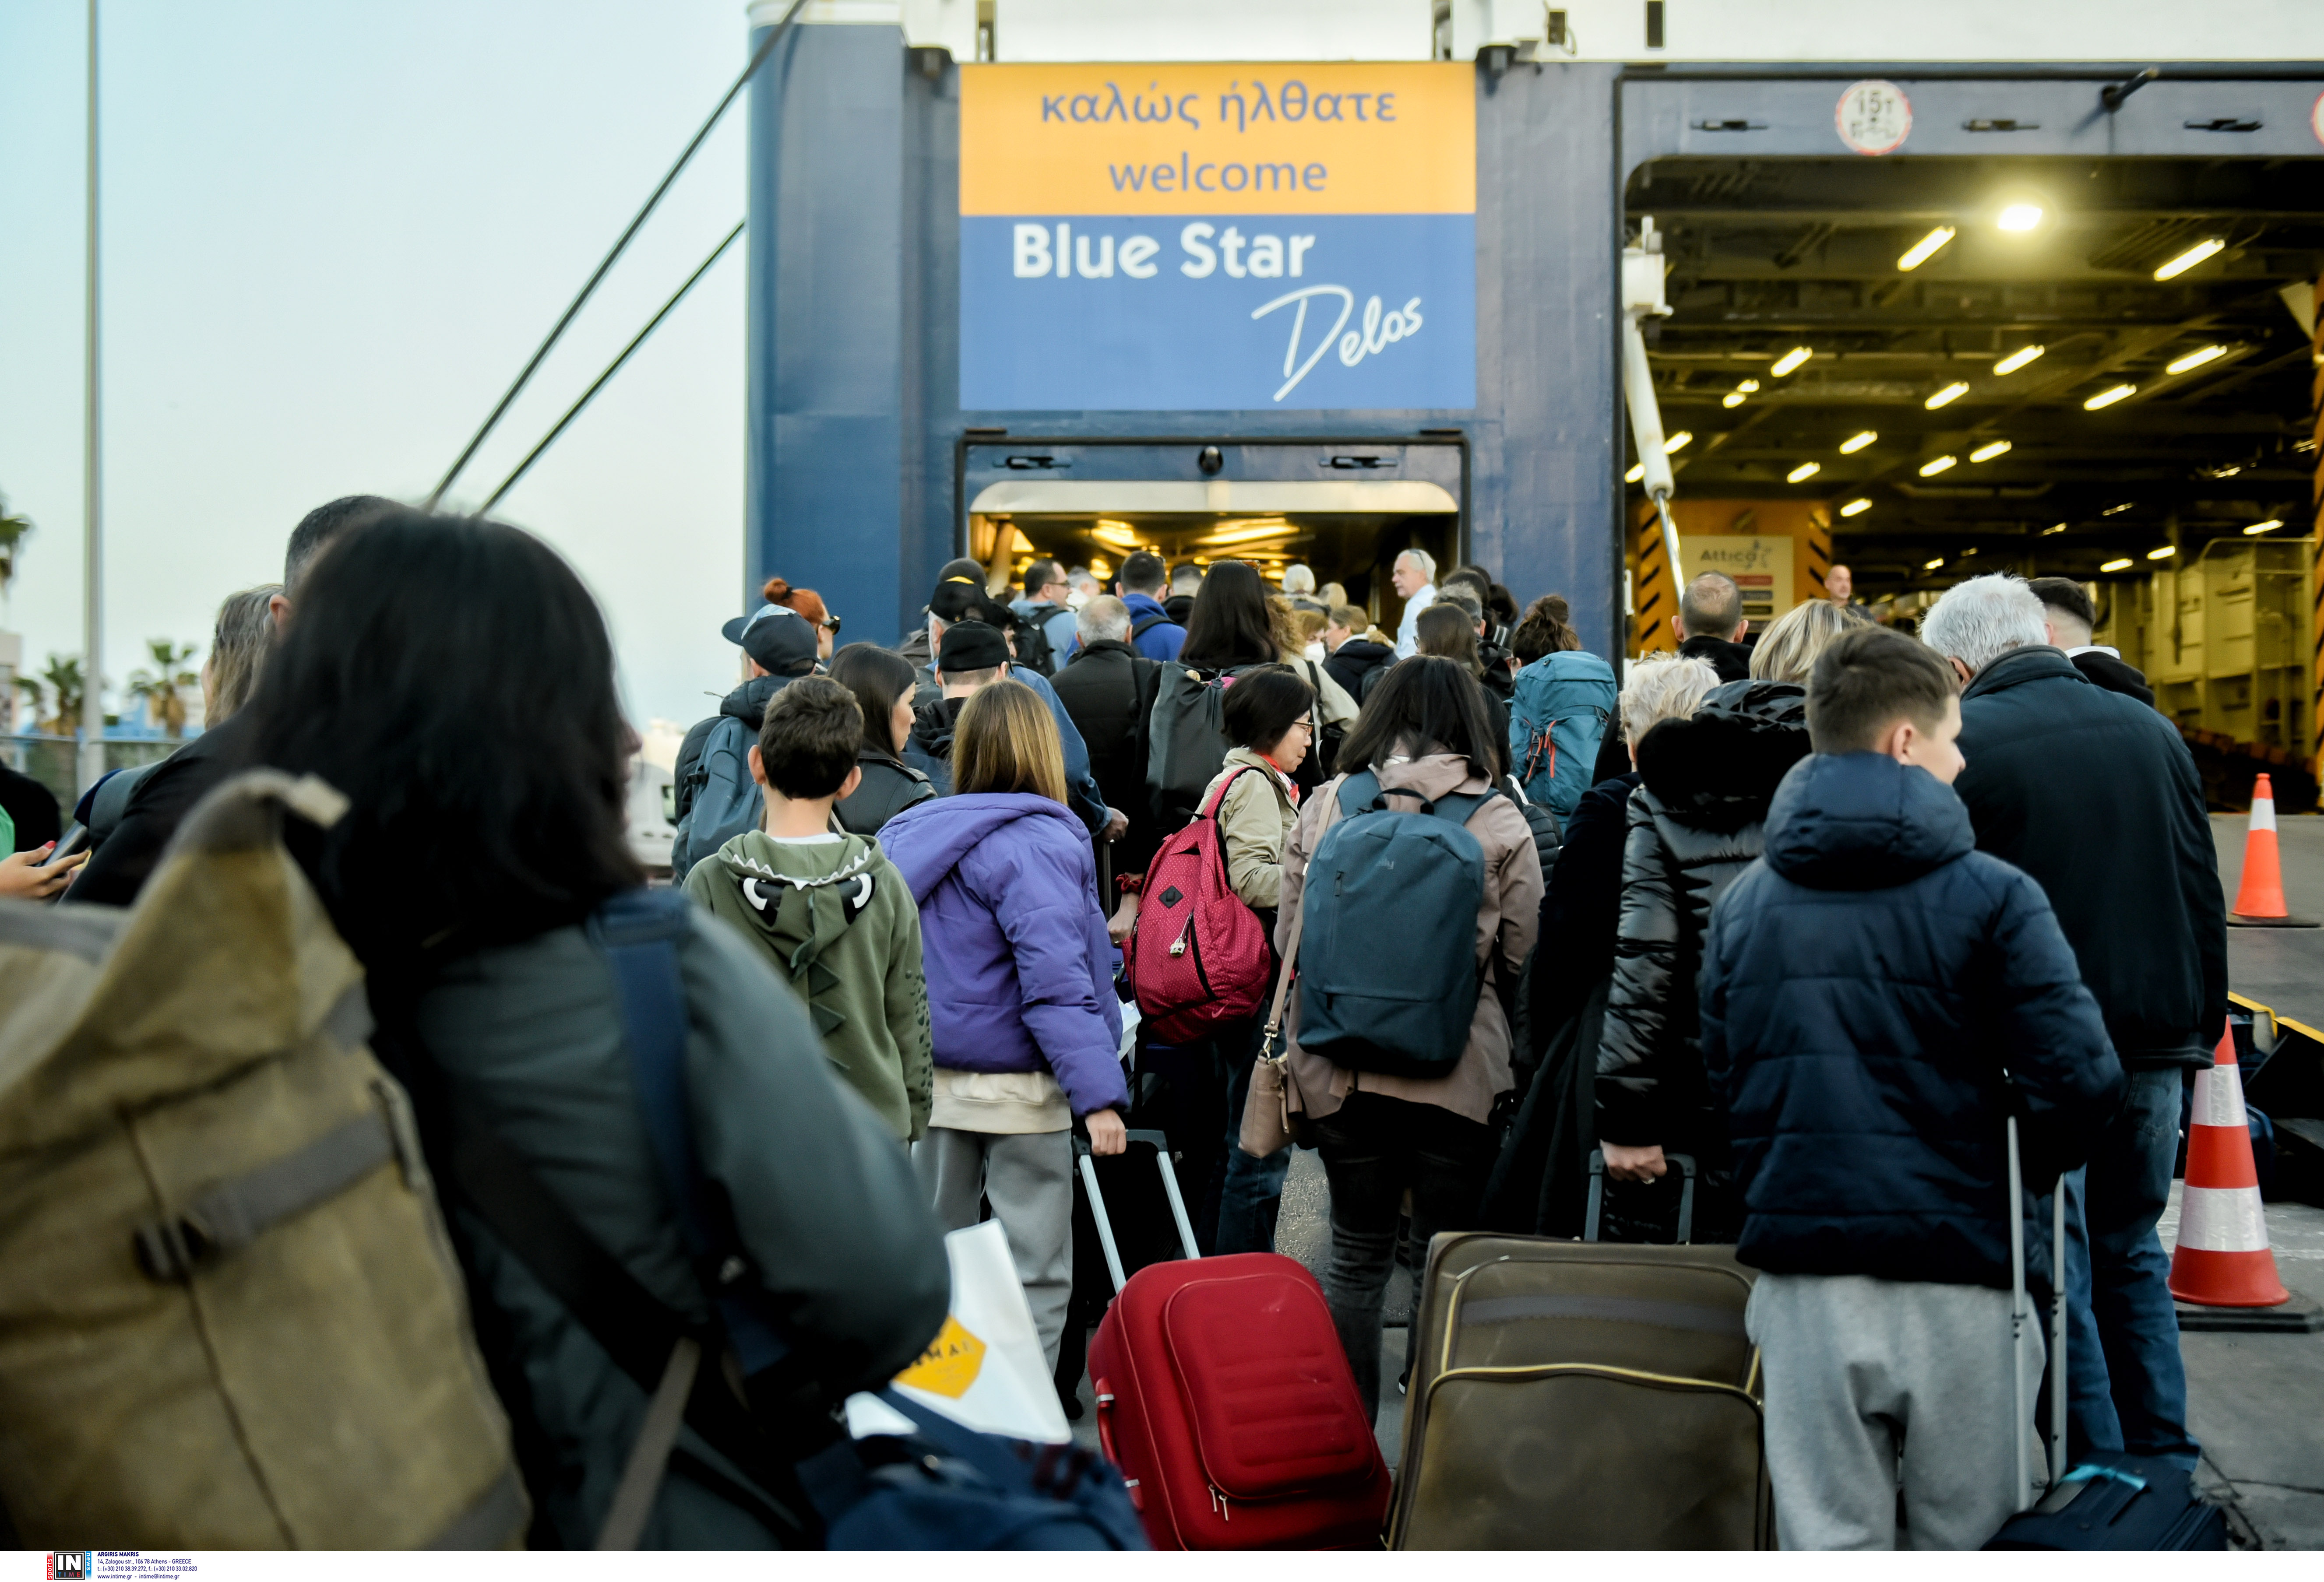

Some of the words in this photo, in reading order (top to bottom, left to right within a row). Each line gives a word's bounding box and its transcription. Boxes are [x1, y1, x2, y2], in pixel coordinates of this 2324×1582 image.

[1041, 81, 1200, 130] καλώς
[1220, 80, 1397, 133] ήλθατε
[1108, 151, 1327, 192] welcome
[1014, 223, 1160, 278] Blue
[1180, 222, 1316, 278] Star
[1251, 284, 1423, 401] Delos
